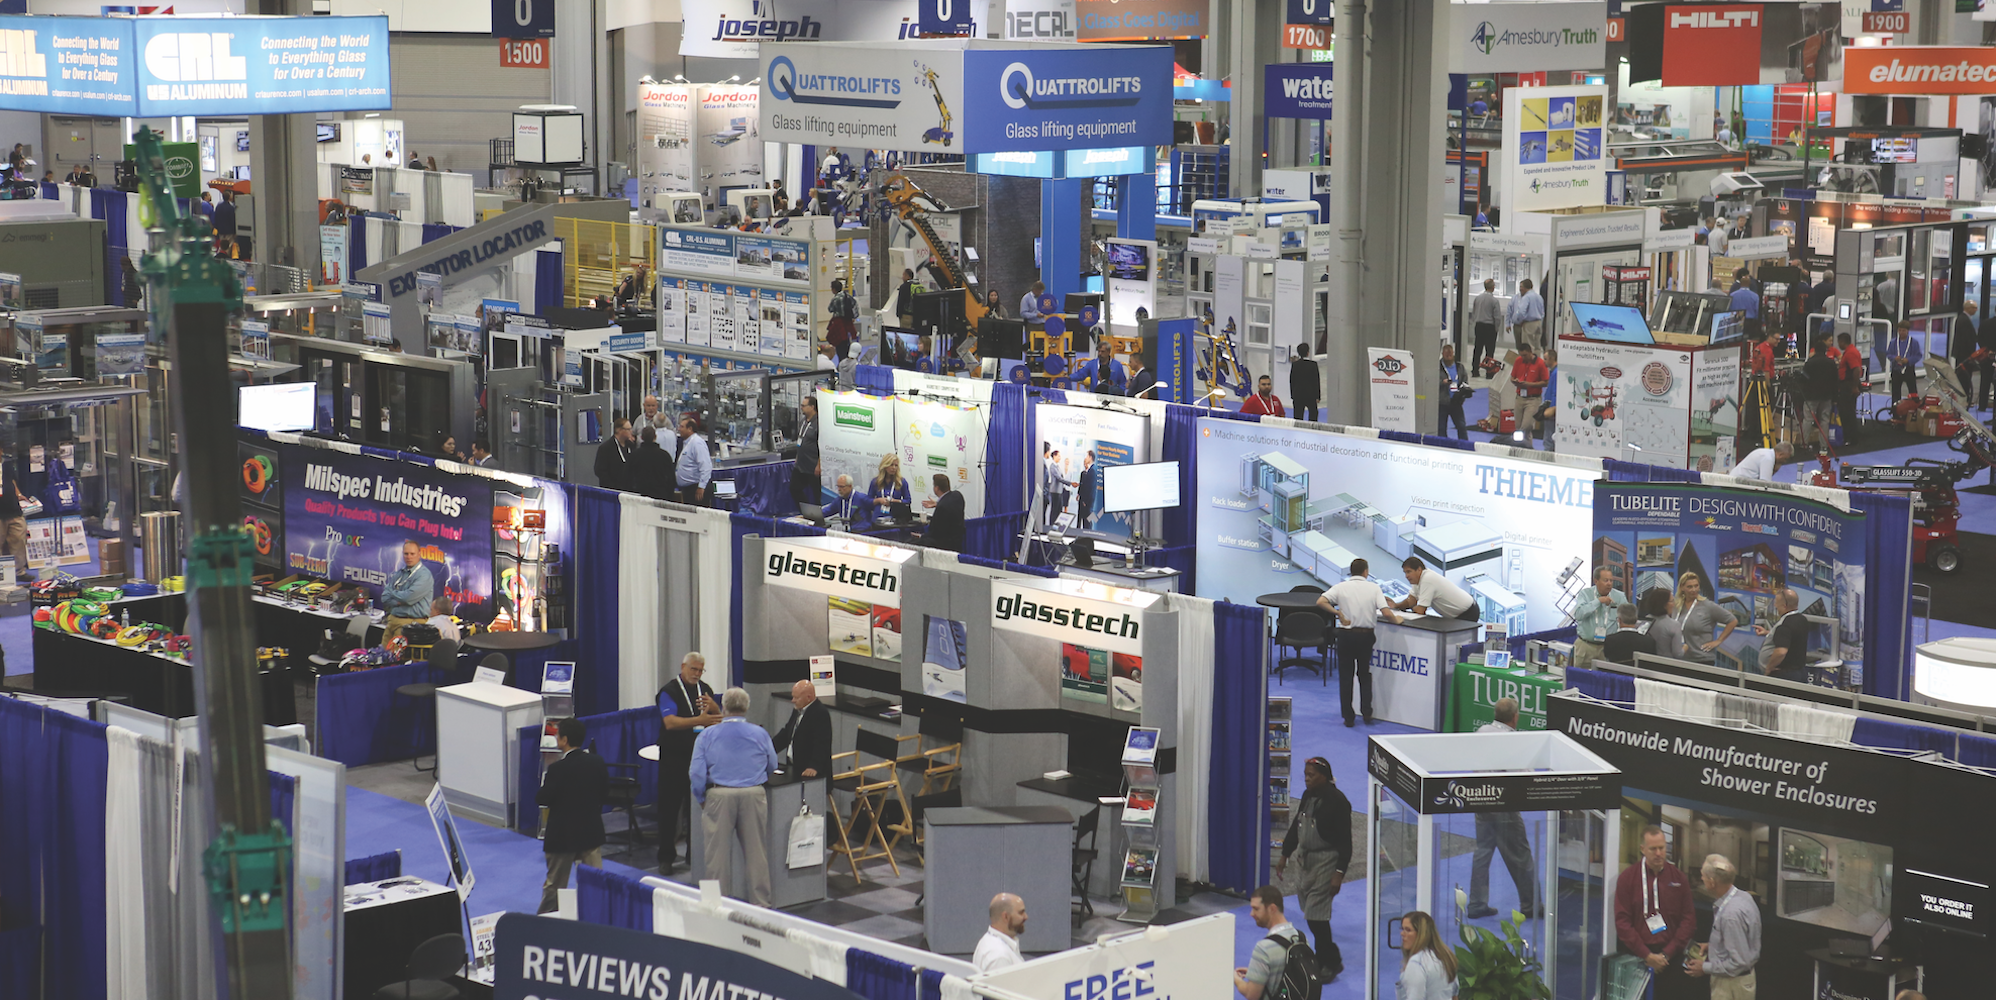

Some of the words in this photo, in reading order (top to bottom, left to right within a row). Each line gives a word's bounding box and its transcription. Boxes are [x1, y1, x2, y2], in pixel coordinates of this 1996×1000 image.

[1085, 13, 1120, 29] Glass
[1123, 11, 1155, 28] Goes
[1158, 11, 1199, 31] Digital
[1671, 11, 1758, 28] HILTI
[1868, 15, 1904, 31] 1900
[712, 15, 821, 42] joseph
[53, 36, 87, 51] Connecting
[89, 37, 98, 49] the
[100, 38, 119, 50] World
[261, 36, 318, 50] Connecting
[321, 35, 336, 48] the
[340, 34, 370, 48] World
[1289, 27, 1325, 47] 1700
[66, 53, 98, 67] Everything
[100, 53, 118, 66] Glass
[269, 53, 278, 65] to
[281, 51, 335, 66] Everything
[338, 50, 366, 63] Glass
[505, 42, 542, 64] 1500
[62, 67, 71, 79] for
[72, 69, 87, 80] Over
[88, 71, 92, 80] a
[94, 69, 118, 84] Century
[274, 67, 288, 80] for
[291, 67, 315, 79] Over
[317, 69, 324, 78] a
[327, 66, 366, 80] Century
[768, 56, 901, 101] QUATTROLIFTS
[1869, 59, 1996, 83] elumatec
[3, 80, 48, 96] ALUMINUM
[171, 83, 247, 100] ALUMINUM
[255, 90, 302, 99] crlaurence.com
[307, 88, 344, 97] usalum.com
[348, 87, 386, 96] crl-arch.com
[1000, 62, 1142, 109] QUATTROLIFTS
[643, 91, 688, 102] Jordon
[702, 92, 757, 103] Jordon
[663, 102, 687, 110] Machinery
[772, 114, 802, 131] Glass
[804, 116, 835, 137] lifting
[838, 119, 897, 139] equipment
[1006, 122, 1039, 139] Glass
[1041, 121, 1074, 140] lifting
[1077, 119, 1137, 139] equipment
[1266, 187, 1285, 195] water
[1560, 228, 1585, 238] Engineered
[1607, 225, 1623, 233] Trusted
[1623, 223, 1640, 232] Results.
[473, 219, 547, 264] LOCATOR
[704, 237, 726, 246] ALUMINUM
[1621, 270, 1650, 279] HILTI
[611, 338, 630, 347] SECURITY
[630, 336, 645, 344] DOORS
[1570, 345, 1595, 353] adaptable
[1595, 346, 1620, 355] hydraulic
[1576, 353, 1605, 361] multilifters
[837, 410, 872, 424] Mainstreet
[1214, 429, 1245, 442] Machine
[1247, 433, 1280, 446] solutions
[1281, 436, 1292, 447] for
[1294, 438, 1328, 453] industrial
[1330, 444, 1370, 459] decoration
[1373, 451, 1388, 461] and
[1390, 453, 1430, 468] functional
[1432, 459, 1464, 474] printing
[305, 463, 371, 499] Milspec
[1873, 469, 1901, 477] GLASSLIFT
[1901, 469, 1922, 477] 550-3D
[1476, 464, 1594, 509] THIEME
[1212, 496, 1226, 506] Rack
[1227, 499, 1247, 508] loader
[1411, 496, 1431, 506] Vision
[1432, 499, 1449, 510] print
[1450, 502, 1485, 514] inspection
[305, 498, 336, 517] Quality
[337, 503, 377, 523] Products
[379, 511, 396, 526] You
[398, 512, 416, 530] Can
[418, 518, 439, 537] Plug
[1610, 494, 1680, 511] TUBELITE
[1689, 497, 1747, 517] DESIGN
[1749, 503, 1785, 522] WITH
[1787, 508, 1841, 540] CONFIDENCE
[325, 525, 342, 543] Pro
[1217, 534, 1237, 544] Buffer
[1238, 538, 1259, 548] station
[1504, 530, 1527, 543] Digital
[1528, 535, 1553, 545] printer
[290, 552, 328, 574] SUB-ZERO
[1272, 560, 1289, 571] Dryer
[343, 565, 388, 586] POWER
[768, 551, 897, 592] glasstech
[444, 586, 485, 605] ProStar
[996, 594, 1139, 639] glasstech
[1568, 716, 1669, 752] Nationwide
[1673, 736, 1803, 777] Manufacturer
[1806, 761, 1828, 783] of
[1454, 784, 1504, 798] Quality
[1700, 767, 1771, 796] Shower
[1775, 780, 1877, 815] Enclosures
[1920, 894, 1937, 903] YOU
[1938, 898, 1966, 909] ORDER
[1924, 903, 1944, 914] ALSO
[1945, 907, 1974, 919] ONLINE
[475, 926, 493, 935] ADAMS
[476, 934, 489, 942] STEEL
[523, 945, 671, 1000] REVIEWS
[1065, 960, 1155, 1000] FREE
